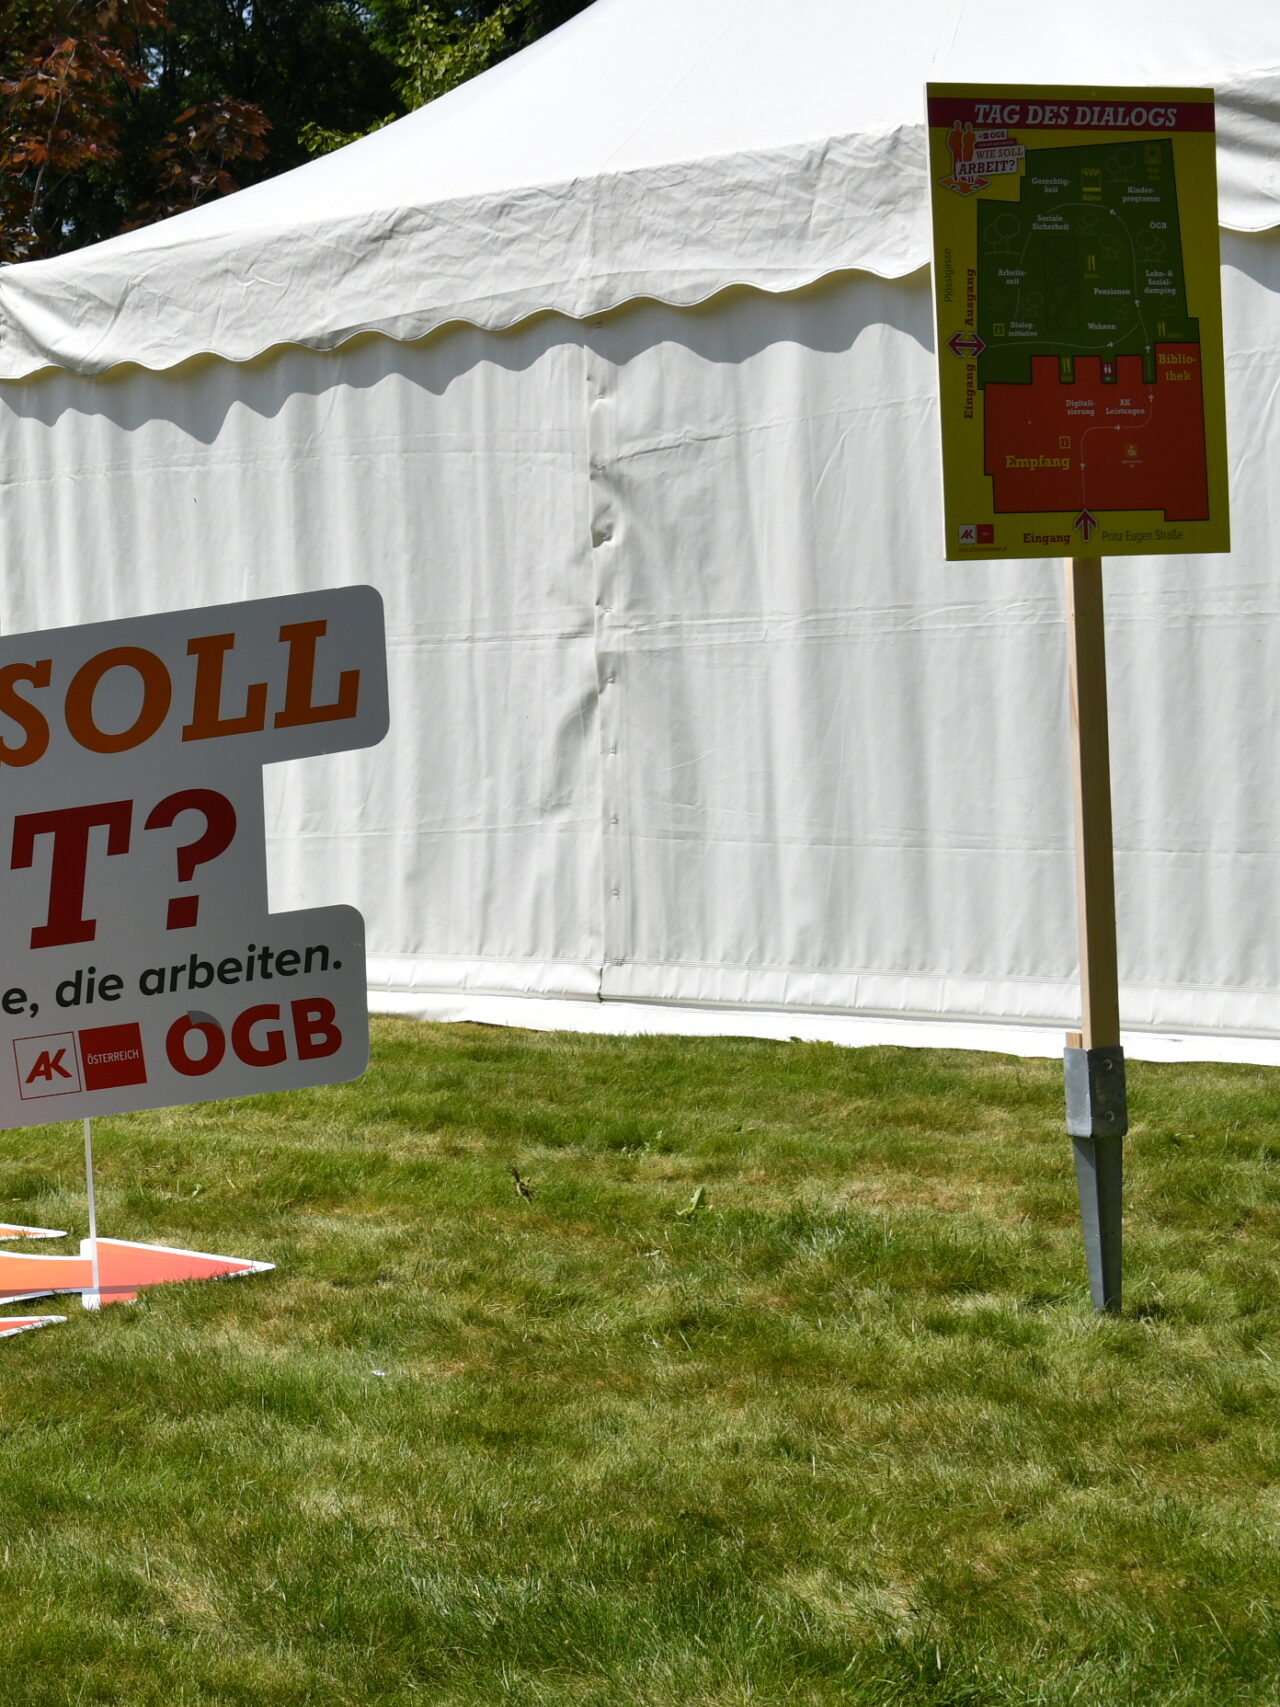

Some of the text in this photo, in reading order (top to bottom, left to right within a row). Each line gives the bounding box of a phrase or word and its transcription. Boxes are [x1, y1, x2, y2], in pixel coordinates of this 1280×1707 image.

[974, 104, 1178, 127] TAG DES DIALOGS
[976, 148, 1024, 160] WIE SOLL
[958, 159, 1016, 175] ARBEIT?
[965, 268, 977, 326] Ausgang
[1158, 354, 1198, 365] Biblio-
[1165, 370, 1192, 381] thek
[964, 363, 977, 419] Eingang
[1105, 407, 1146, 416] Leistungen
[1005, 455, 1071, 471] Empfang
[1023, 532, 1071, 545] Eingang
[1102, 530, 1124, 541] Prinz
[1126, 530, 1153, 543] Eugen
[55, 966, 124, 1008] die
[139, 943, 342, 997] arbeiten.
[86, 1048, 140, 1066] ÖSTERREICH
[25, 1047, 73, 1084] AK
